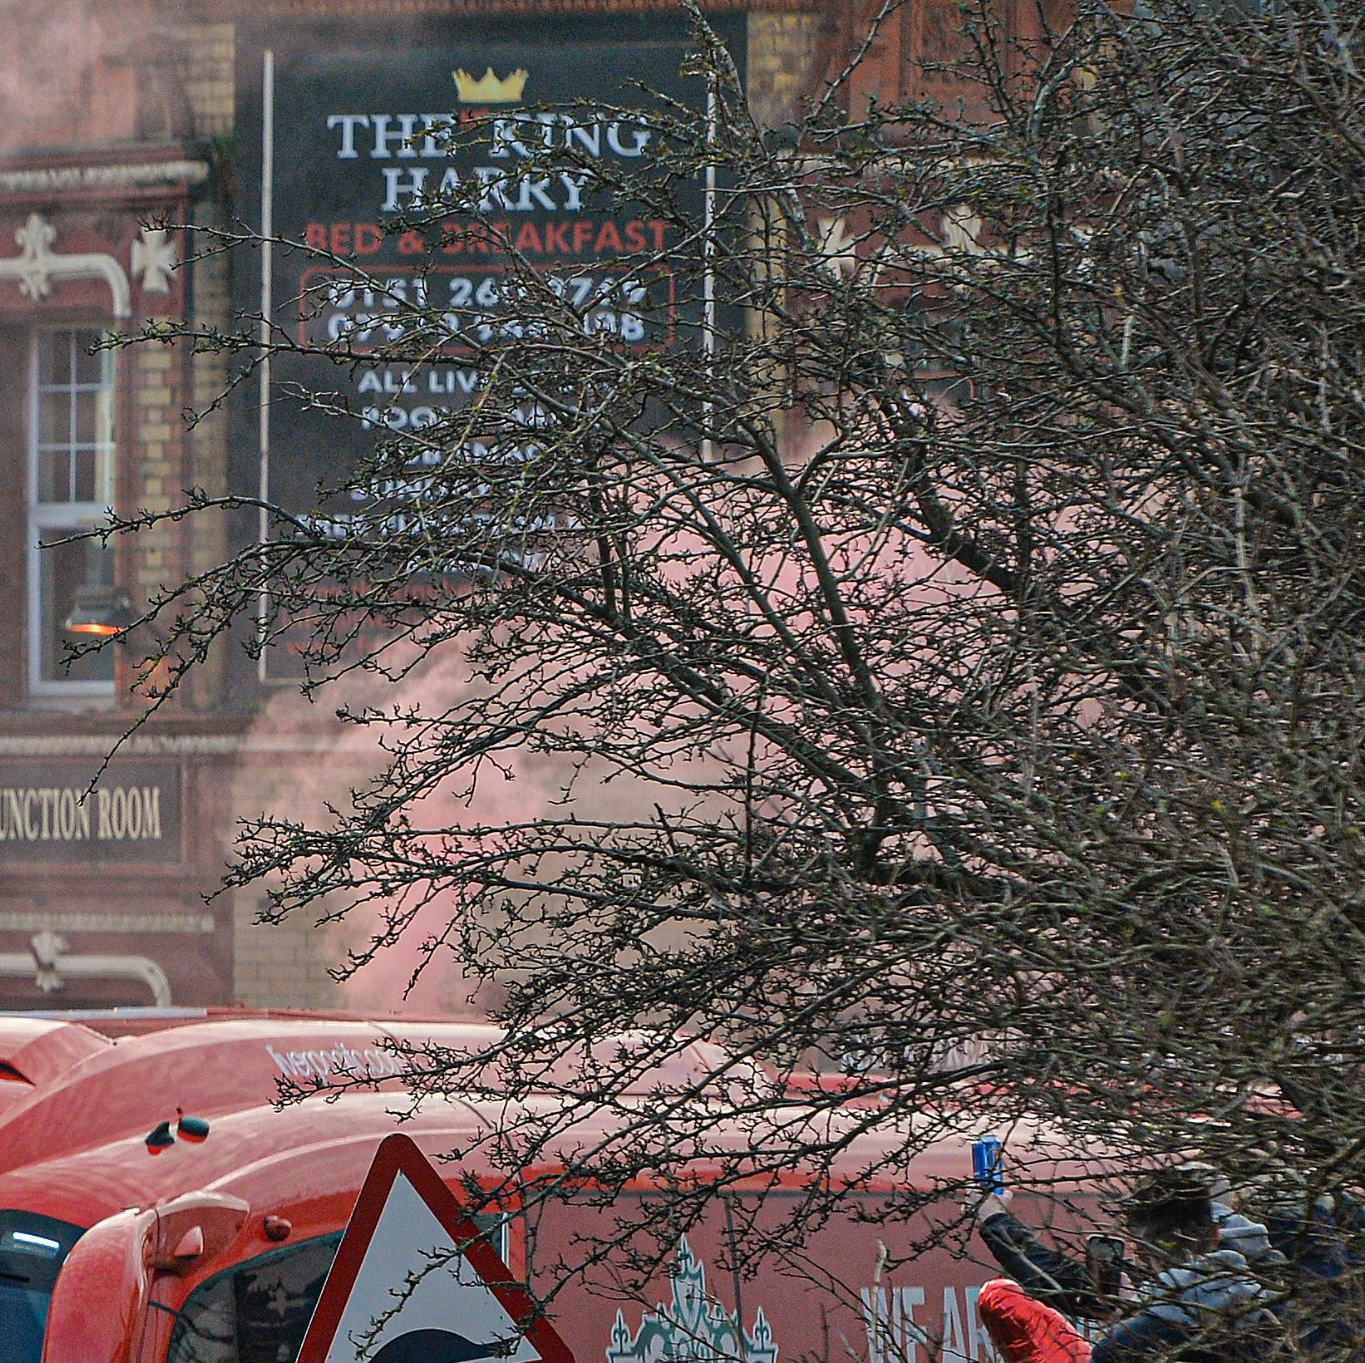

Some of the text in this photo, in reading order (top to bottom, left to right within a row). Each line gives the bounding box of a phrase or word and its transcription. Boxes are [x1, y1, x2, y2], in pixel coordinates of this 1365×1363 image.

[327, 111, 652, 158] THE KING
[382, 166, 595, 211] HARRY
[306, 220, 671, 254] BED & BREAKFAST
[328, 276, 428, 308] 0151
[357, 369, 418, 394] ALL
[97, 786, 162, 840] ROOM
